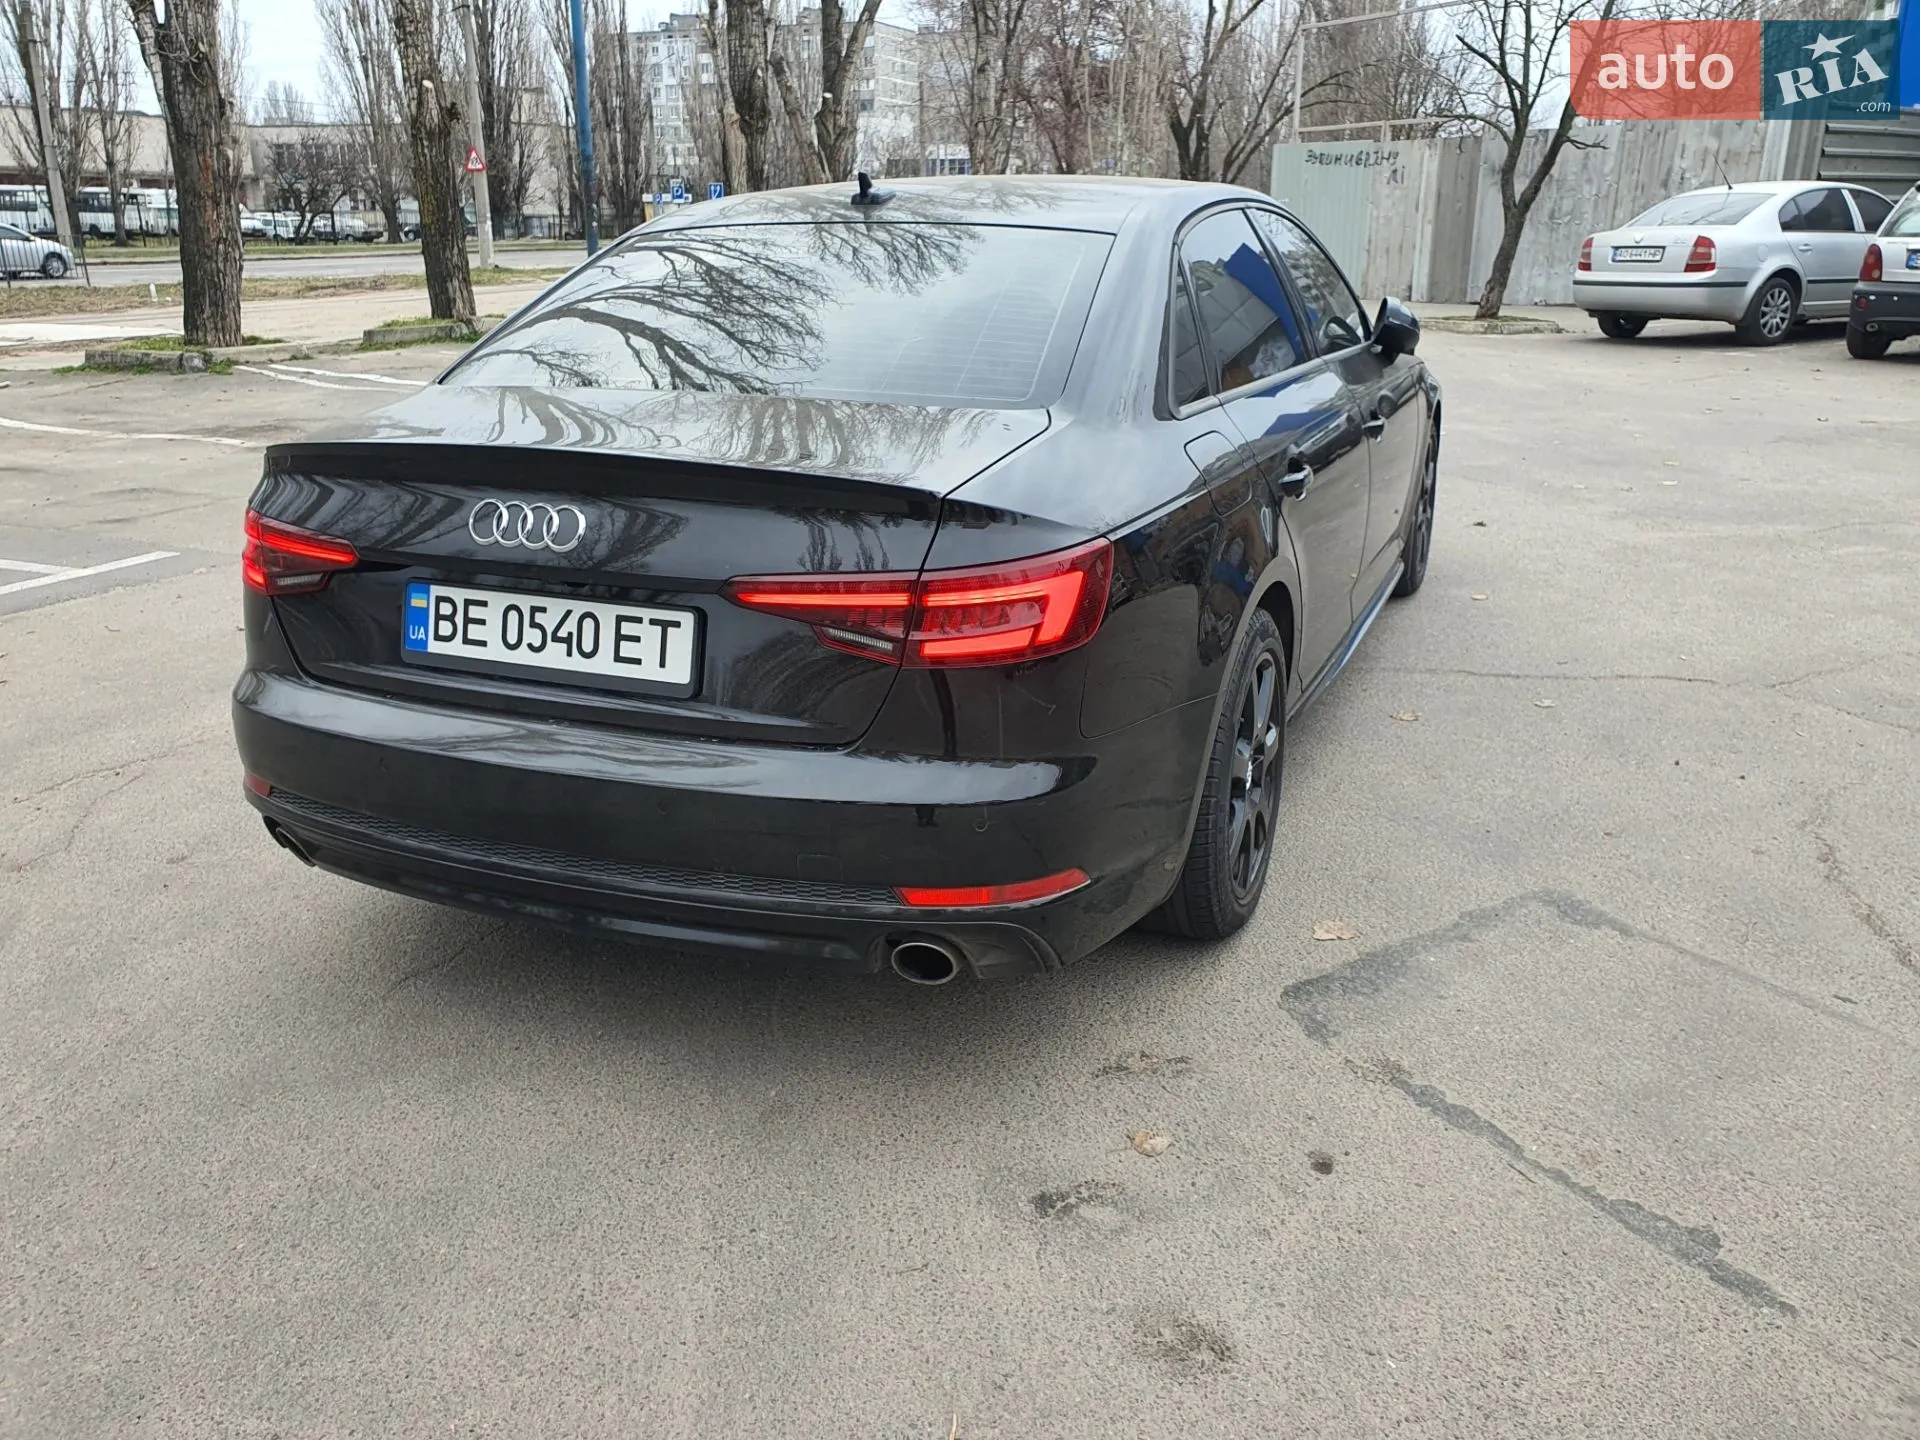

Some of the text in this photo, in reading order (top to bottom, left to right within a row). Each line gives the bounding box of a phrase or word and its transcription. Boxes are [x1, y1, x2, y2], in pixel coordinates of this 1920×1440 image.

[409, 626, 426, 640] UA
[433, 595, 681, 668] BE 0540 ET
